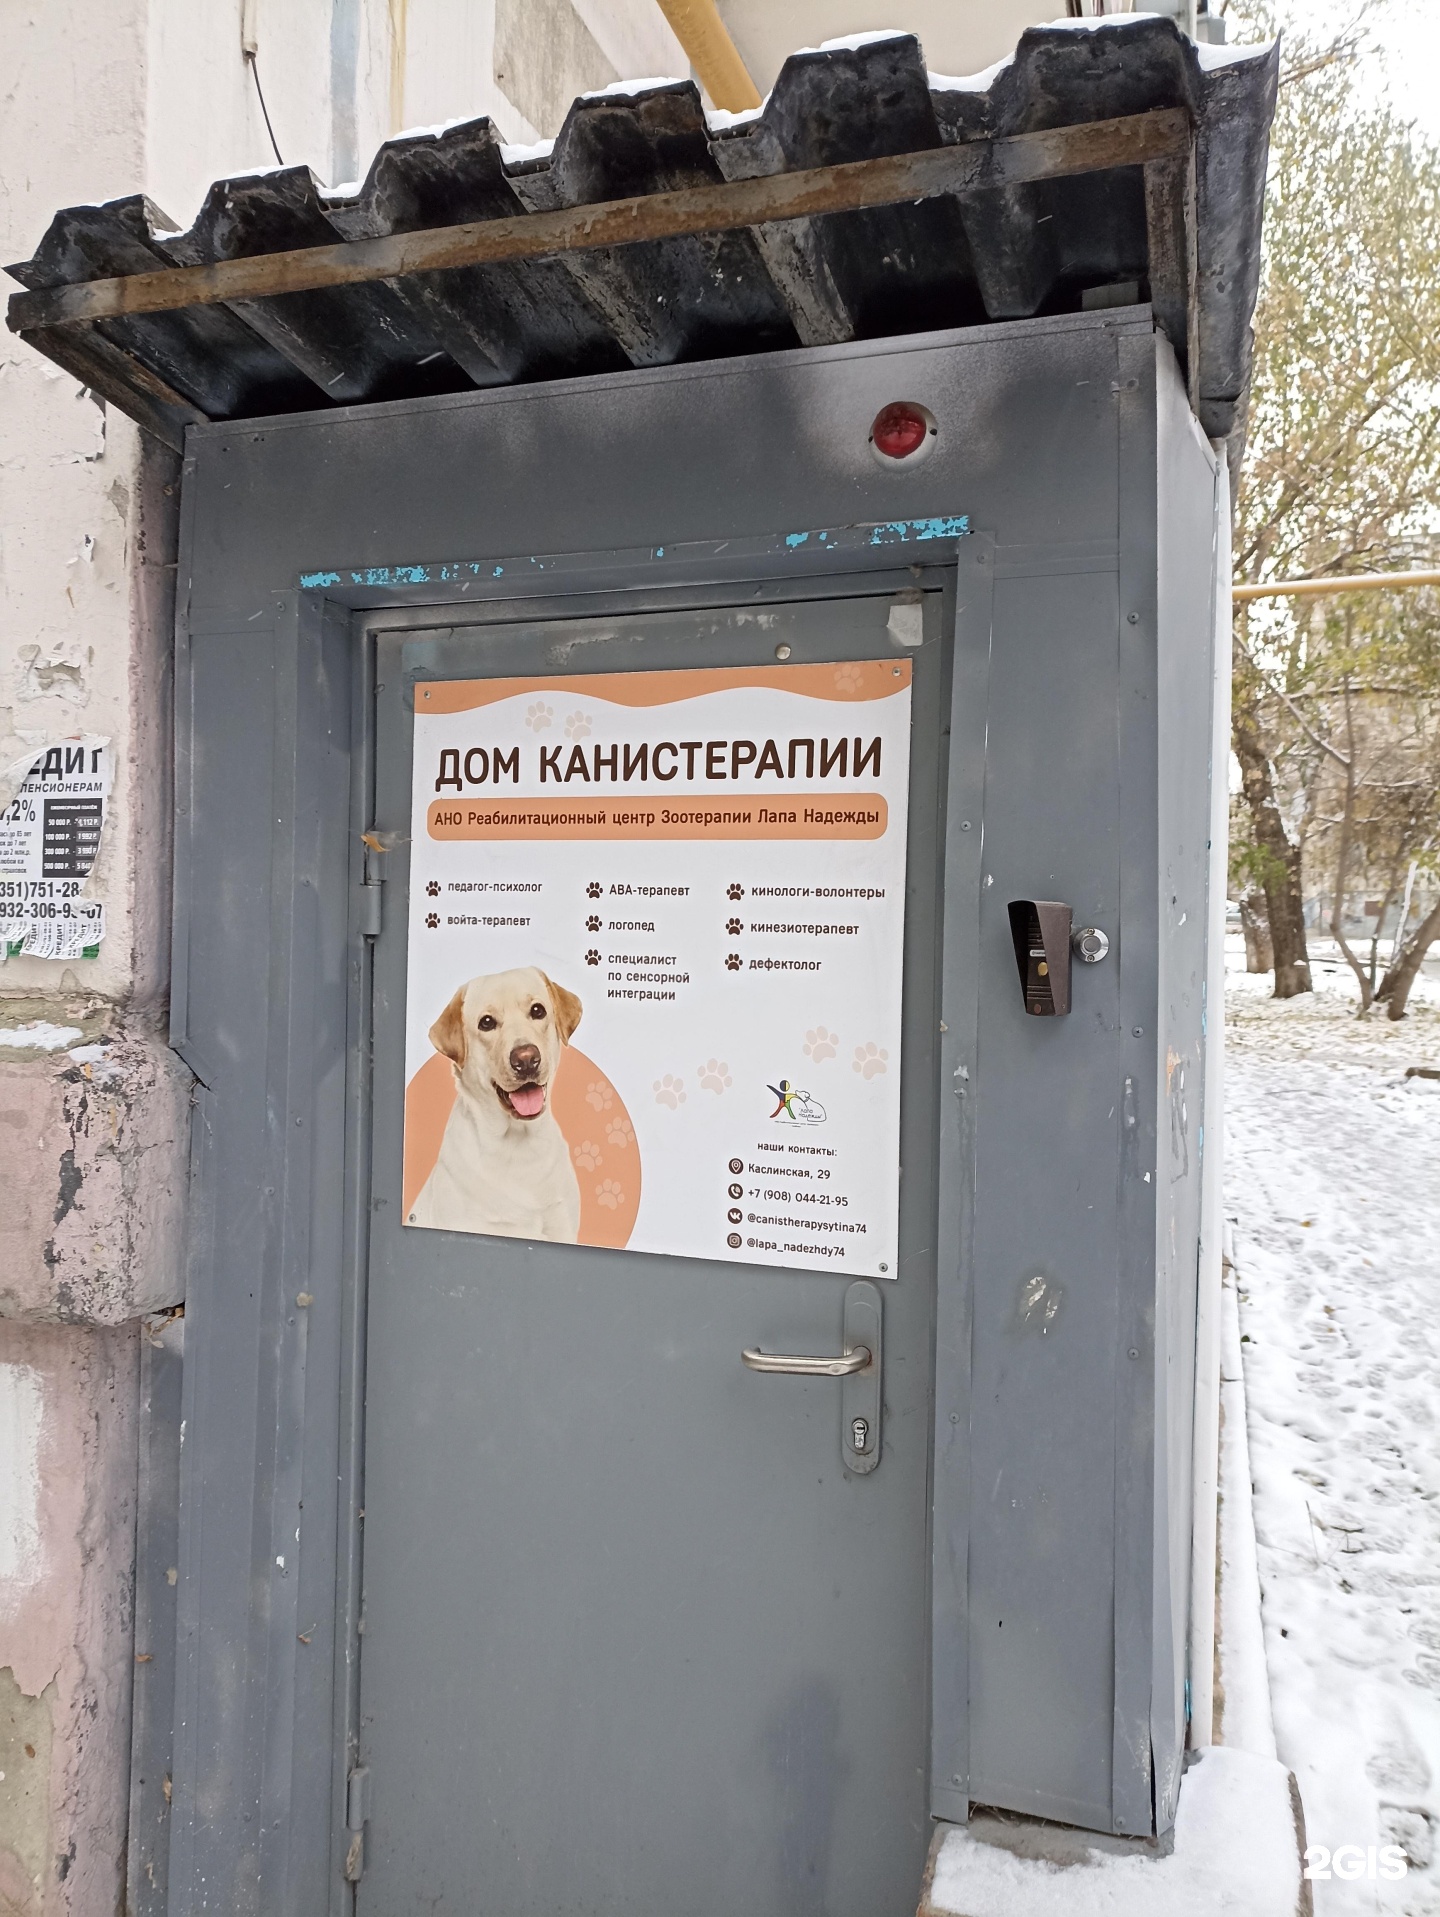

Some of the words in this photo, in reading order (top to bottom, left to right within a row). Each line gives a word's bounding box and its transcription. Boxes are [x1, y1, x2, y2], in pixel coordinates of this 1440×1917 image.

[434, 745, 519, 792] ДОМ
[539, 736, 882, 783] КАНИСТЕРАПИИ
[20, 782, 103, 793] ПЕНСИОНЕРАМ
[434, 812, 462, 825] АНО
[468, 809, 606, 827] Реабилитационный
[612, 811, 655, 827] центр
[660, 809, 752, 826] Зоотерапии
[757, 808, 797, 824] Лапа
[803, 807, 880, 825] Надежды
[0, 881, 82, 901] 351)751-28
[447, 881, 543, 893] педагог-психолог
[609, 884, 690, 897] АВА-терапевт
[751, 886, 886, 900] кинологи-волонтеры
[447, 914, 531, 927] войта-терапевт
[608, 920, 655, 932] логопед
[750, 922, 860, 936] кинезиотерапевт
[55, 923, 63, 955] КРЕДИТ
[608, 954, 677, 966] специалист
[748, 958, 822, 972] дефектолог
[608, 971, 622, 982] по
[626, 971, 690, 984] сенсорной
[607, 988, 676, 1001] интеграции
[757, 1142, 784, 1153] наши
[788, 1143, 838, 1157] контакты:
[748, 1163, 814, 1180] Каслинская,
[817, 1169, 831, 1180] 29
[748, 1188, 760, 1199] +7
[763, 1189, 791, 1203] (908)
[795, 1192, 849, 1207] 044-21-95
[747, 1212, 867, 1234] @canistherapysytina74
[746, 1237, 846, 1257] @lapa_nadezhdy74
